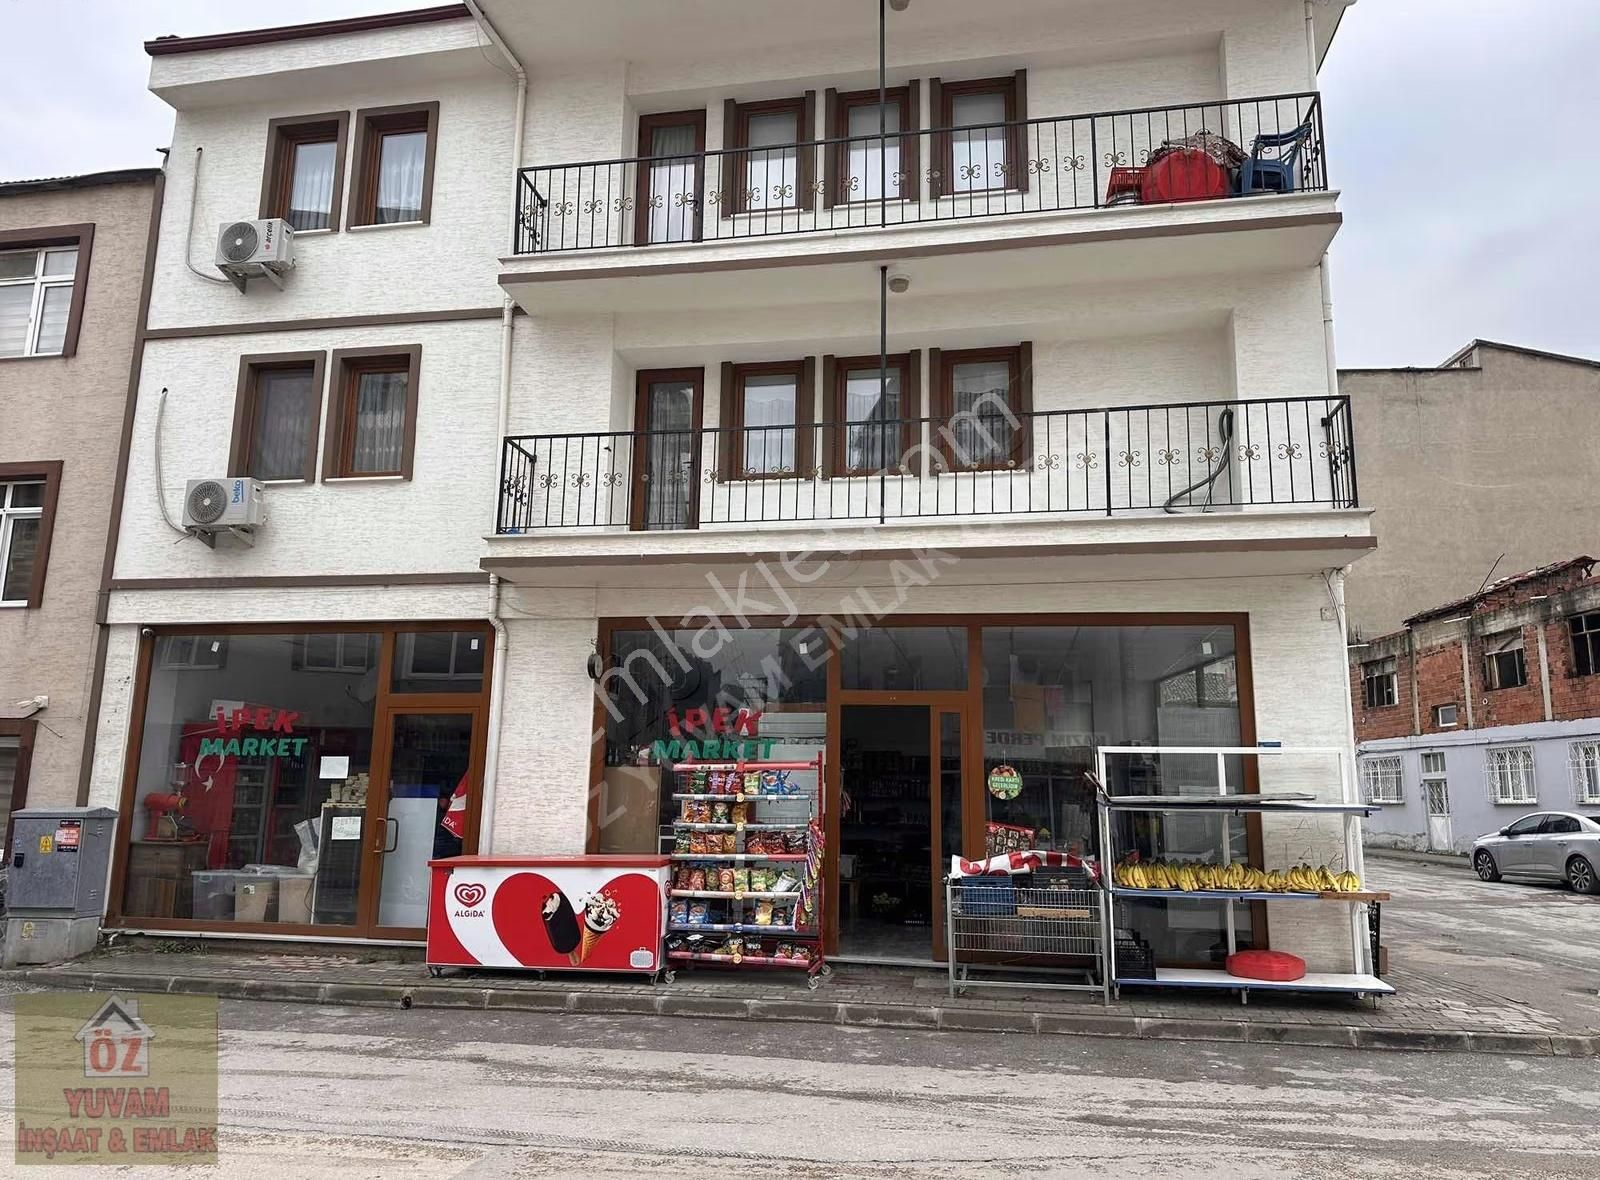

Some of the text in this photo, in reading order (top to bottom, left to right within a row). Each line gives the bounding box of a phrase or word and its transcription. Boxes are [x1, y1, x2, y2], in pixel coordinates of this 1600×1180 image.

[231, 480, 242, 503] beko
[215, 705, 300, 734] İPEK
[666, 704, 763, 737] İPEK
[199, 737, 309, 757] MARKET
[651, 739, 778, 760] MARKET
